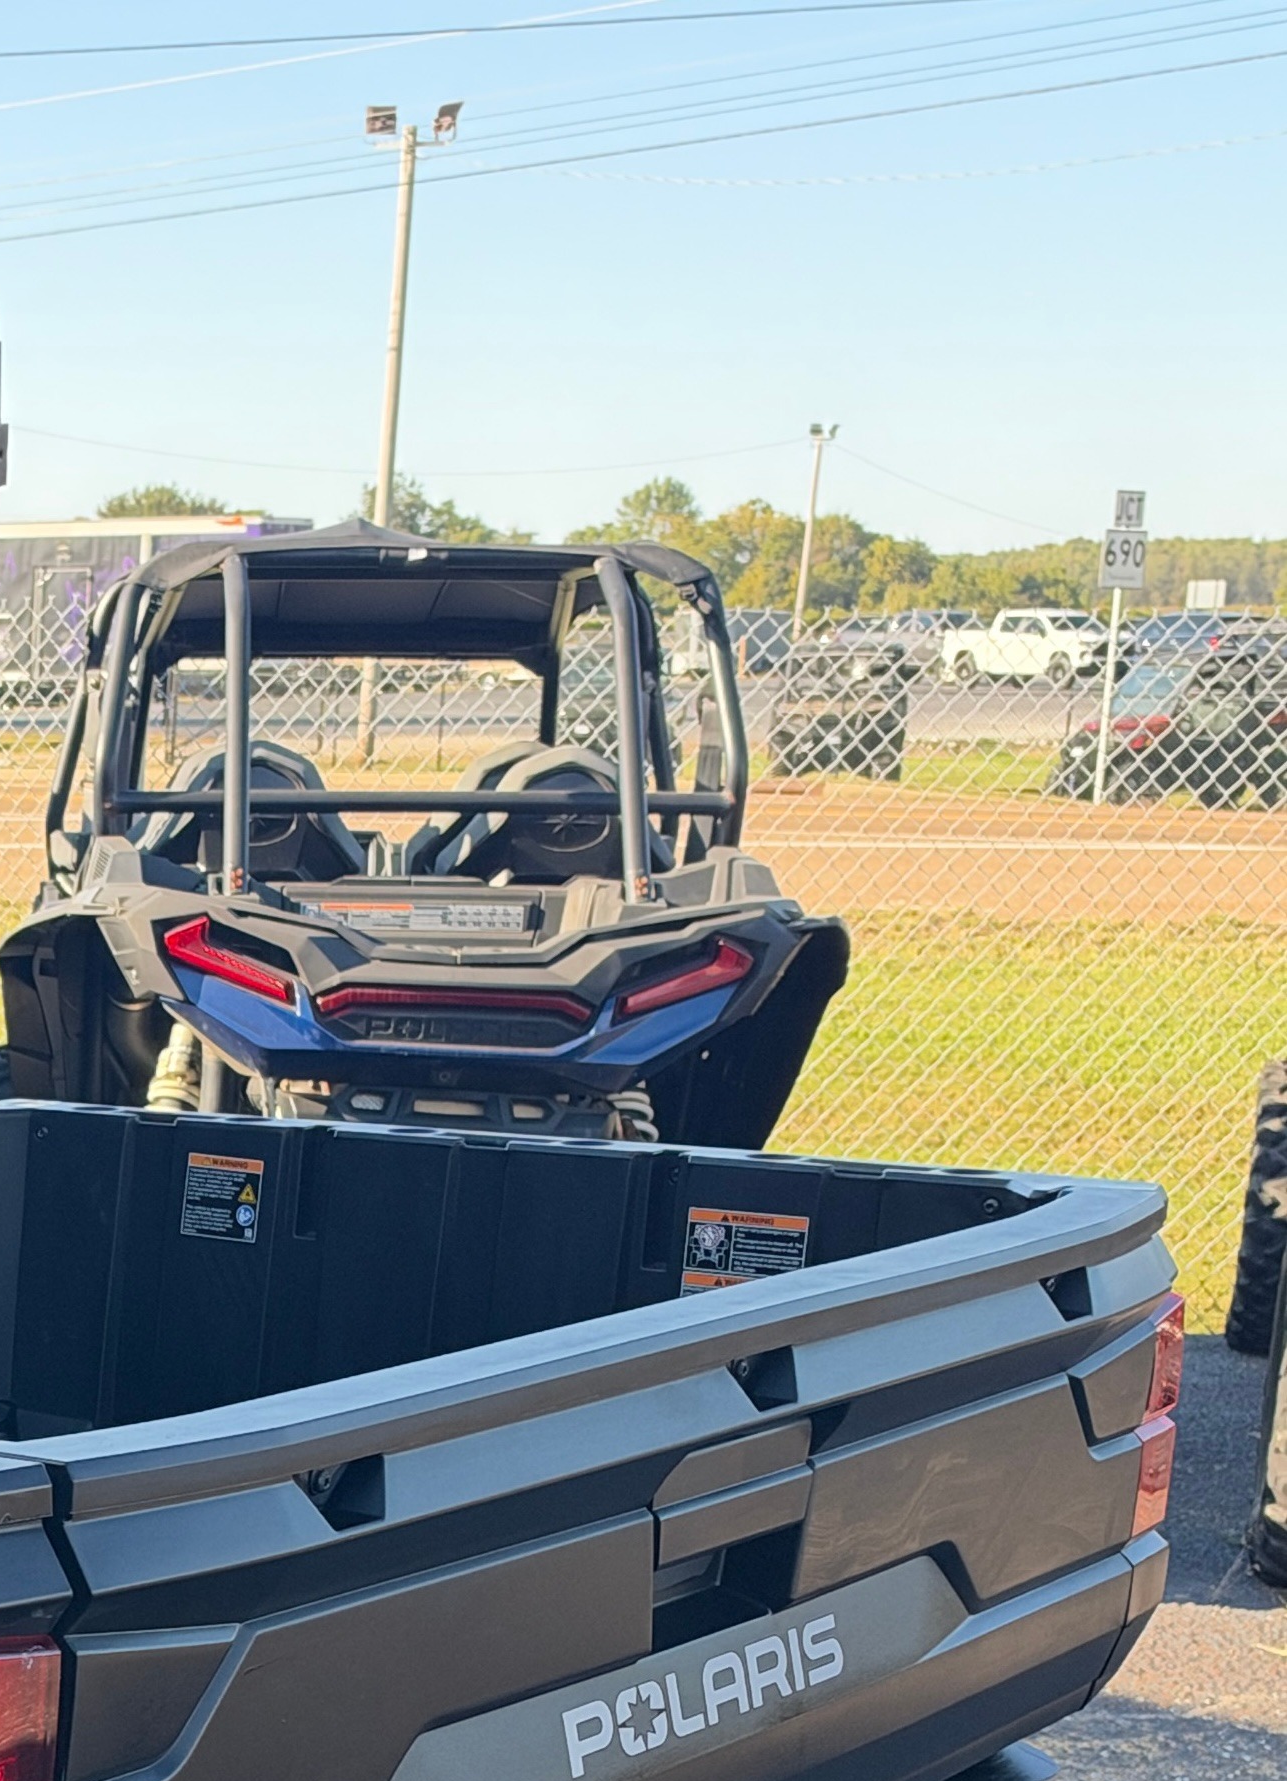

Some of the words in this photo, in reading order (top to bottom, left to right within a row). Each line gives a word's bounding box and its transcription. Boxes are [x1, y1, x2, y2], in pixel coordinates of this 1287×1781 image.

[1116, 497, 1145, 521] JCT
[1105, 539, 1145, 567] 690
[212, 1157, 248, 1169] WARNING
[731, 1214, 775, 1226] WARNING
[562, 1613, 844, 1779] POLARIS
